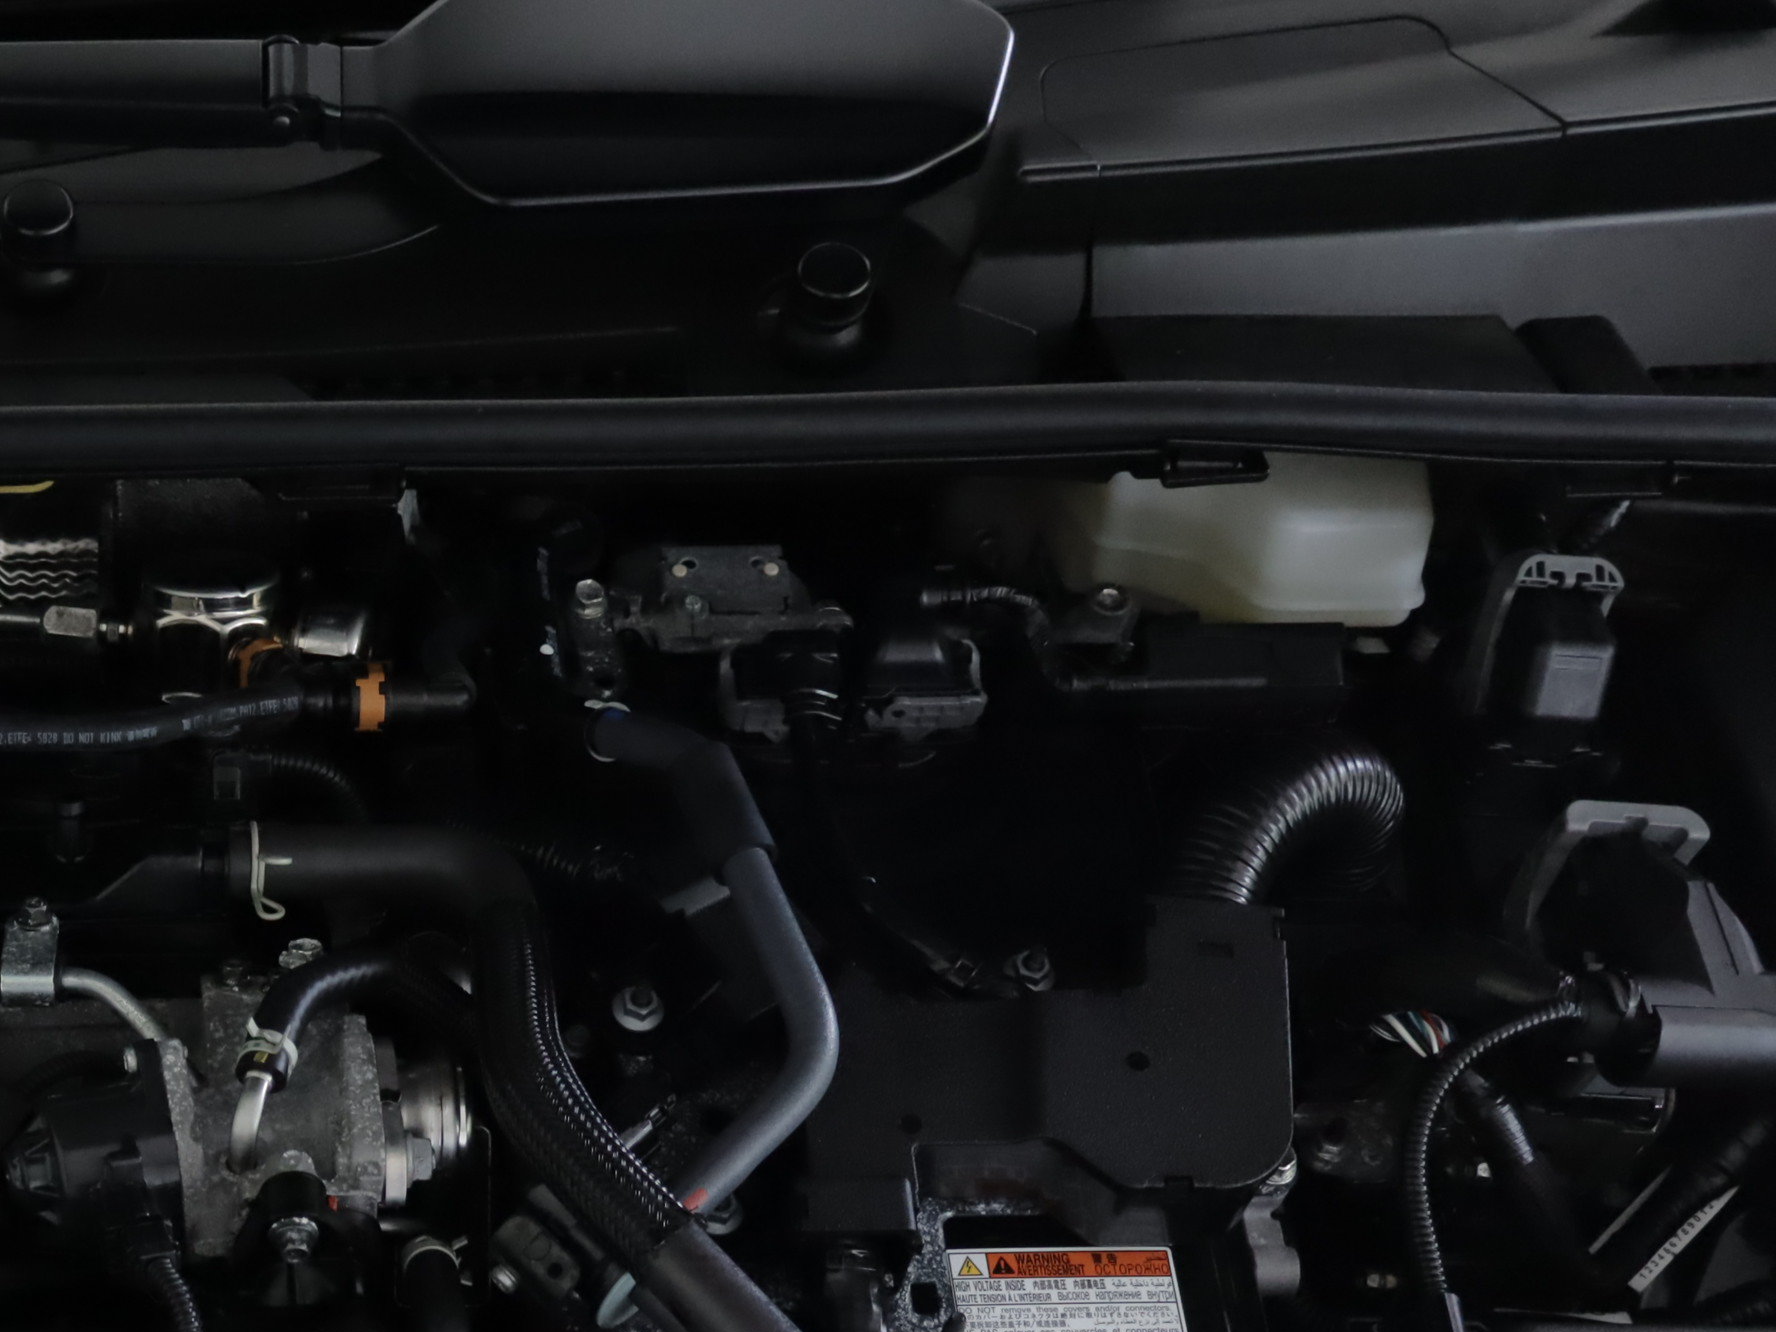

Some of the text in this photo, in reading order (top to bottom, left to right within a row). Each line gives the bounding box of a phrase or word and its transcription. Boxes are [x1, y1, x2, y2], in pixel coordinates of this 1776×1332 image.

[1013, 1252, 1071, 1265] WARNING
[1091, 1252, 1118, 1264] 警告
[1016, 1263, 1086, 1276] AVERTISSEMENT
[1093, 1263, 1170, 1276] ОСТОРОЖНО
[955, 1279, 1026, 1292] HIGH VOLTAGE INSIDE
[956, 1293, 979, 1304] HAUTE
[979, 1293, 1007, 1303] TENSION
[977, 1306, 996, 1314] NOT
[1001, 1306, 1032, 1314] remove
[1036, 1305, 1059, 1313] these
[1063, 1305, 1091, 1313] covers
[1094, 1304, 1120, 1313] and/or
